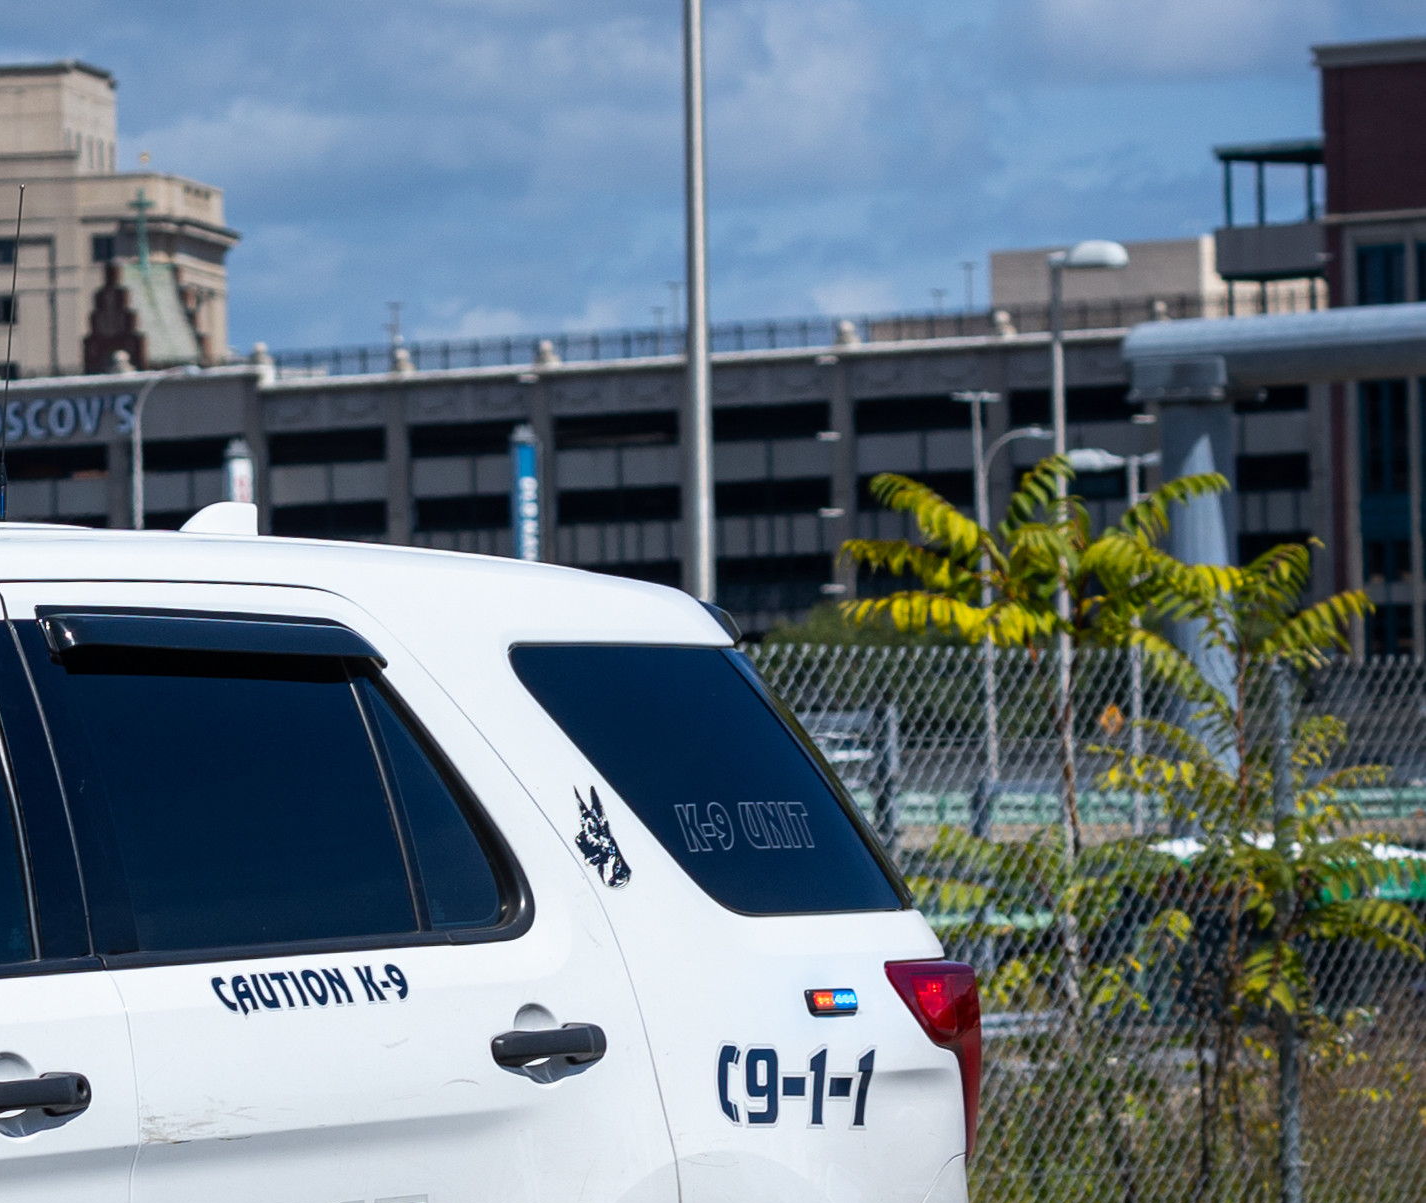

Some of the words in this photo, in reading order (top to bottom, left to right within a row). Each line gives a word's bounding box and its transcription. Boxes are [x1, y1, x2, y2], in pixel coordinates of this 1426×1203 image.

[674, 802, 733, 852] K-9
[738, 801, 815, 850] UNIT
[211, 967, 355, 1016] CAUTION
[360, 963, 410, 1004] K-9
[715, 1040, 877, 1129] C9-1-1
